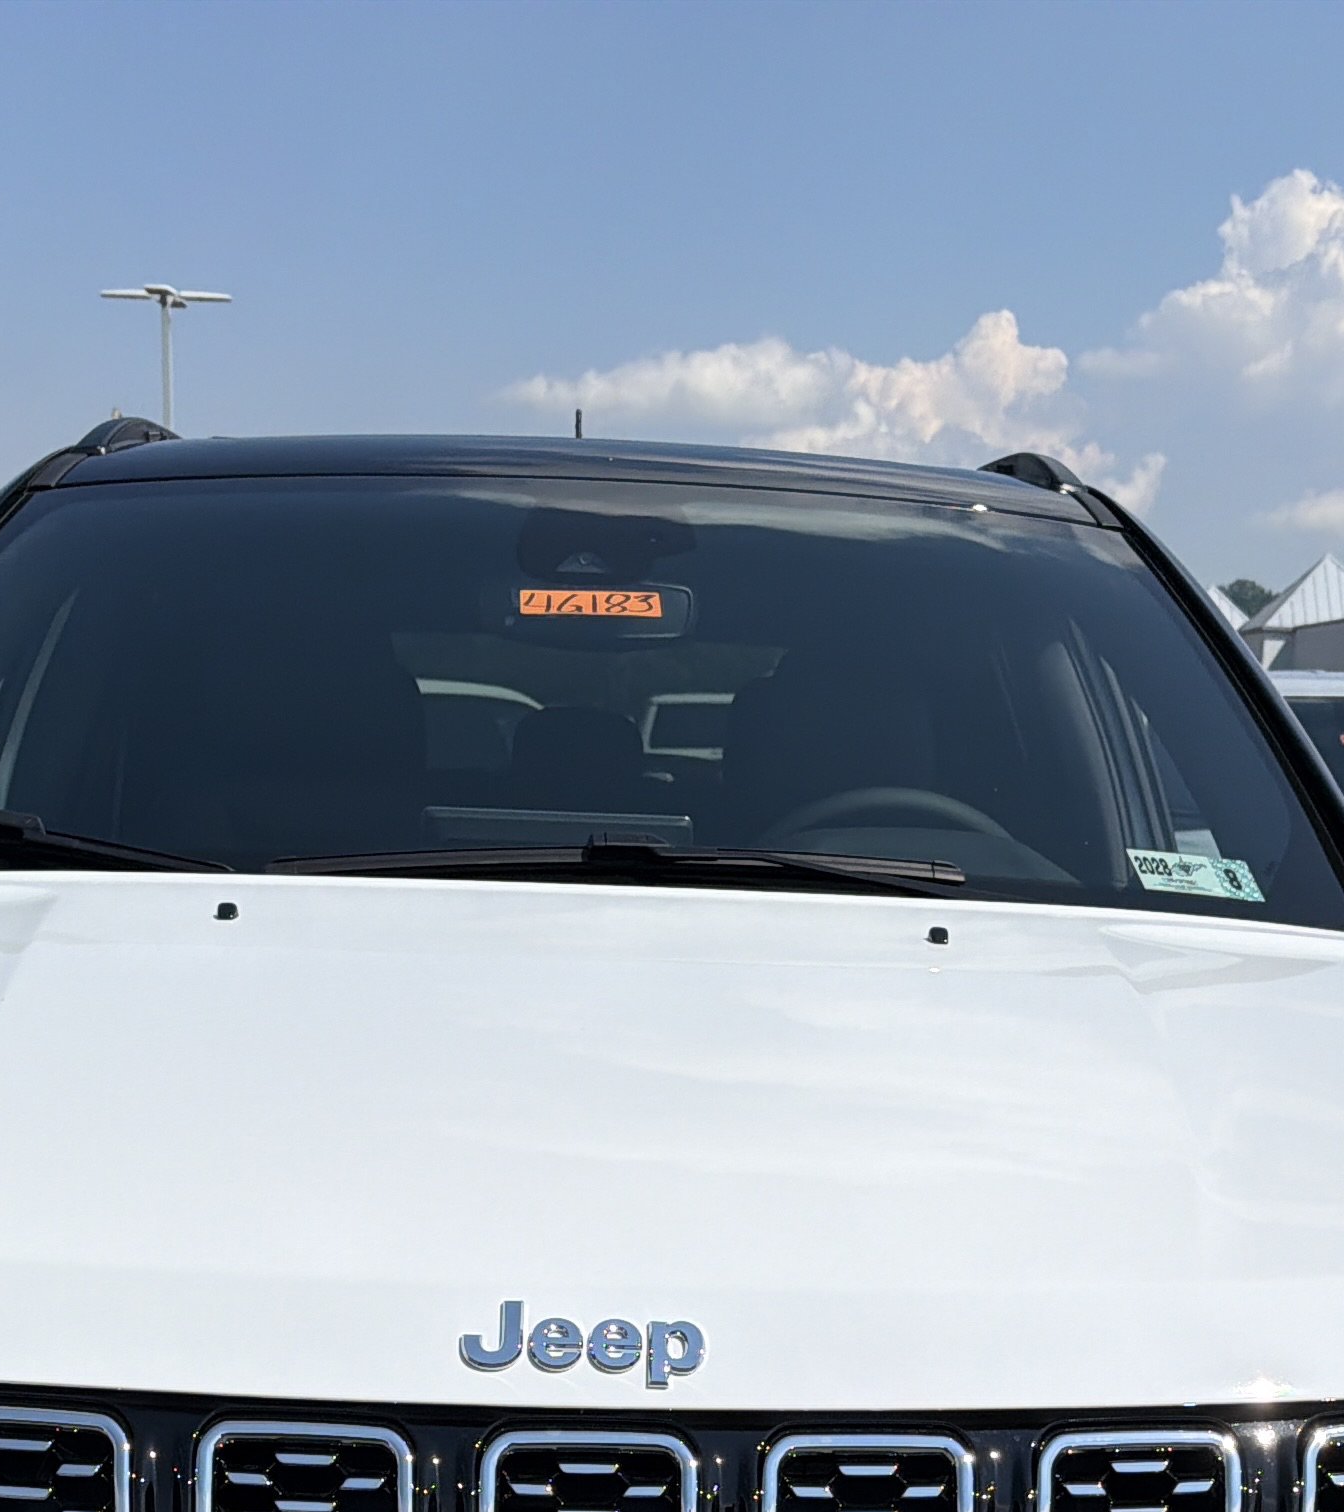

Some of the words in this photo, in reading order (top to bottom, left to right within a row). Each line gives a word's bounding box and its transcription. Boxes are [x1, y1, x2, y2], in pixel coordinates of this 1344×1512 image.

[523, 592, 657, 614] 46183
[1133, 855, 1173, 877] 2028
[1223, 868, 1243, 891] 8
[459, 1300, 707, 1390] Jeep
